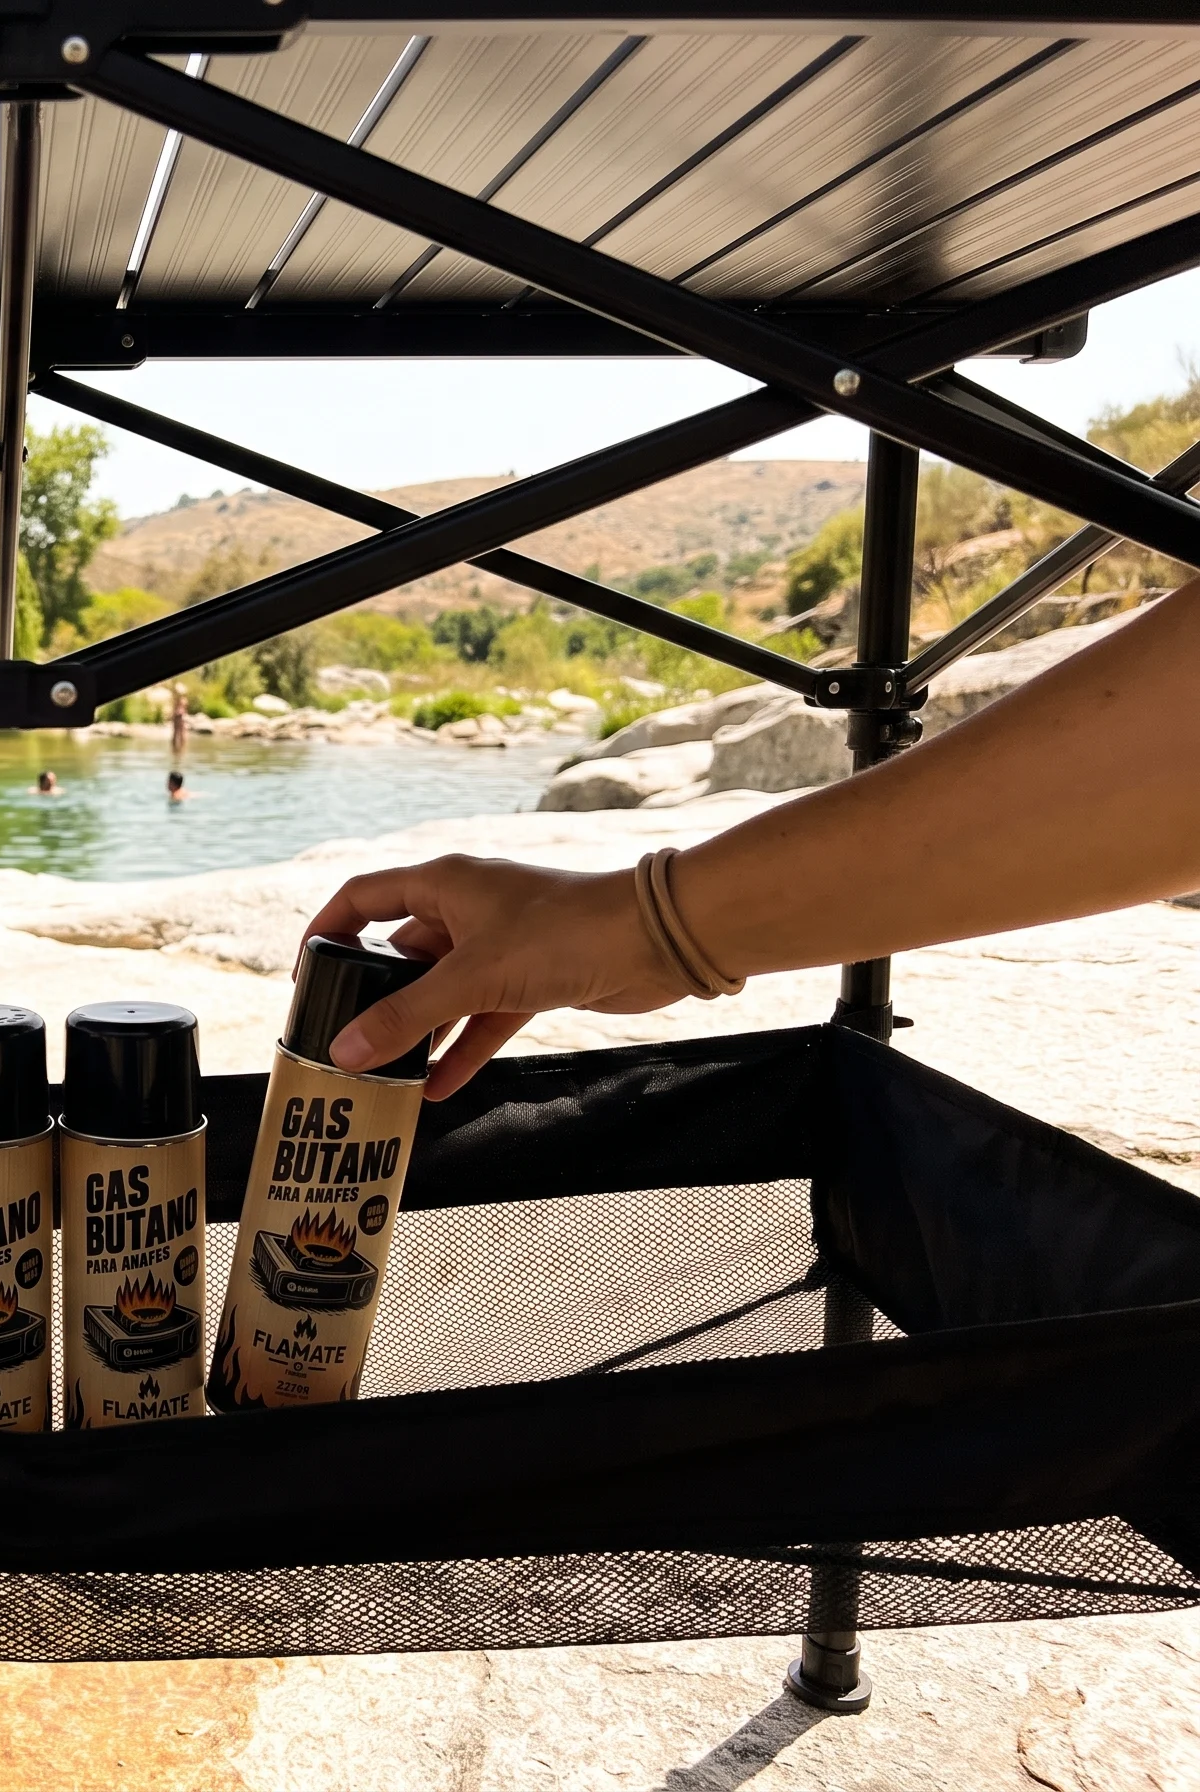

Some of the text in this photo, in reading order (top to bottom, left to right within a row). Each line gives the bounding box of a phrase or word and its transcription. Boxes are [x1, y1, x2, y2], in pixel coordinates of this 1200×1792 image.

[281, 1097, 354, 1139] GAS
[272, 1136, 402, 1184] BUTANO
[86, 1165, 150, 1214] GAS
[267, 1184, 359, 1204] PARA ANAFES
[86, 1187, 198, 1257] BUTANO
[86, 1257, 116, 1274] PARA
[121, 1245, 171, 1272] ANAFES
[253, 1329, 347, 1364] FLAMATE
[103, 1393, 190, 1420] FLAMATE
